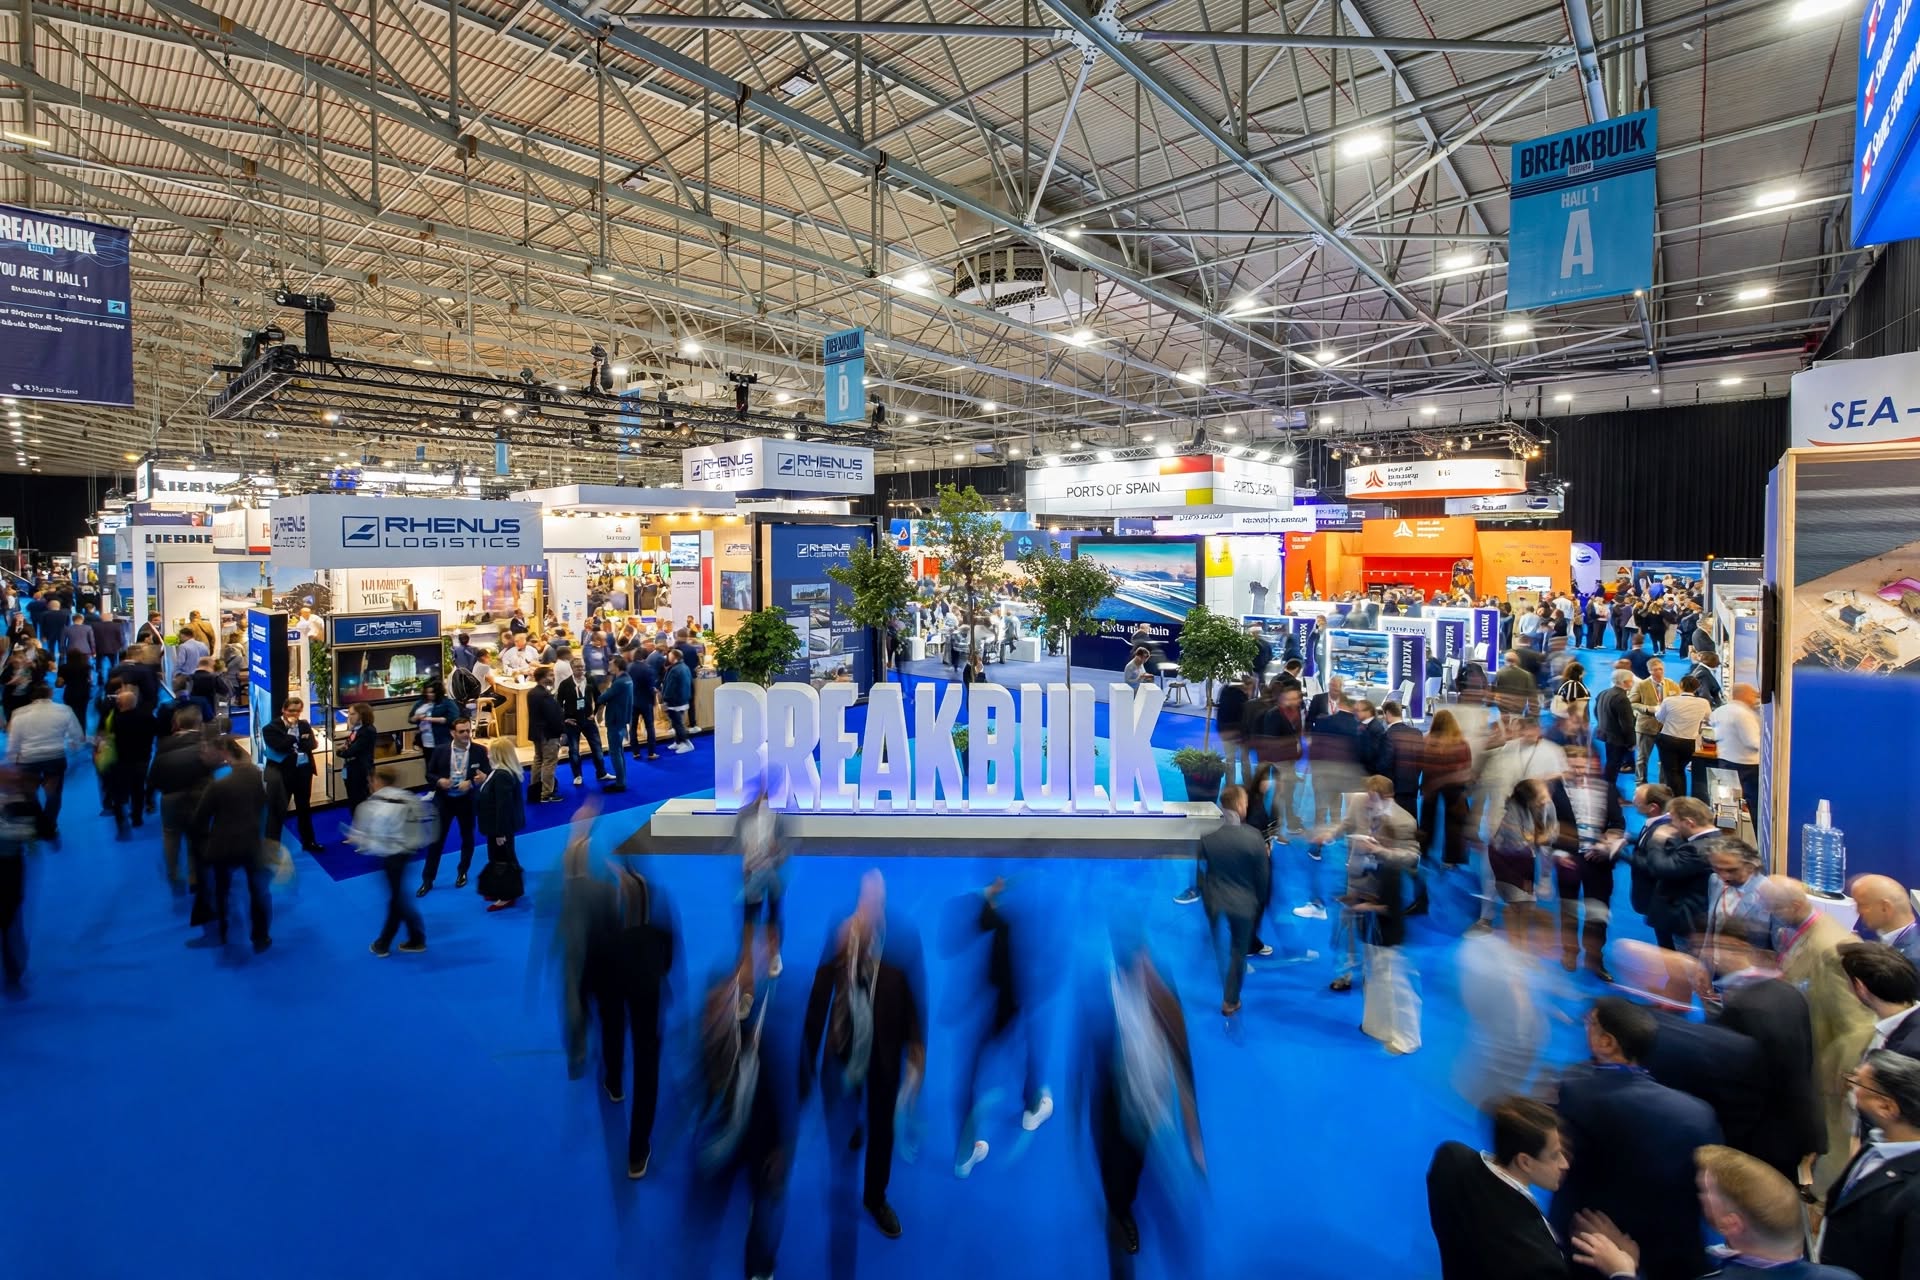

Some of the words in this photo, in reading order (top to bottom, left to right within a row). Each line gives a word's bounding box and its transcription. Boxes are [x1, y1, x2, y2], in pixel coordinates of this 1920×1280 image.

[1520, 117, 1647, 179] BREAKBULK
[1561, 189, 1588, 209] HALL
[1592, 186, 1599, 202] 1
[1560, 208, 1594, 279] A
[20, 265, 39, 281] ARE
[43, 269, 53, 282] IN
[56, 271, 80, 287] HALL
[83, 276, 88, 288] 1
[1828, 396, 1899, 430] SEA
[703, 453, 753, 470] RHENUS
[797, 454, 863, 470] RHENUS
[703, 466, 754, 481] LOGISTICS
[797, 469, 863, 481] LOGISTICS
[1066, 485, 1104, 498] PORTS
[1106, 484, 1122, 496] OF
[1125, 481, 1160, 495] SPAIN
[384, 516, 521, 534] RHENUS
[385, 537, 520, 548] LOGISTICS
[714, 682, 1165, 813] BREAKBULK
